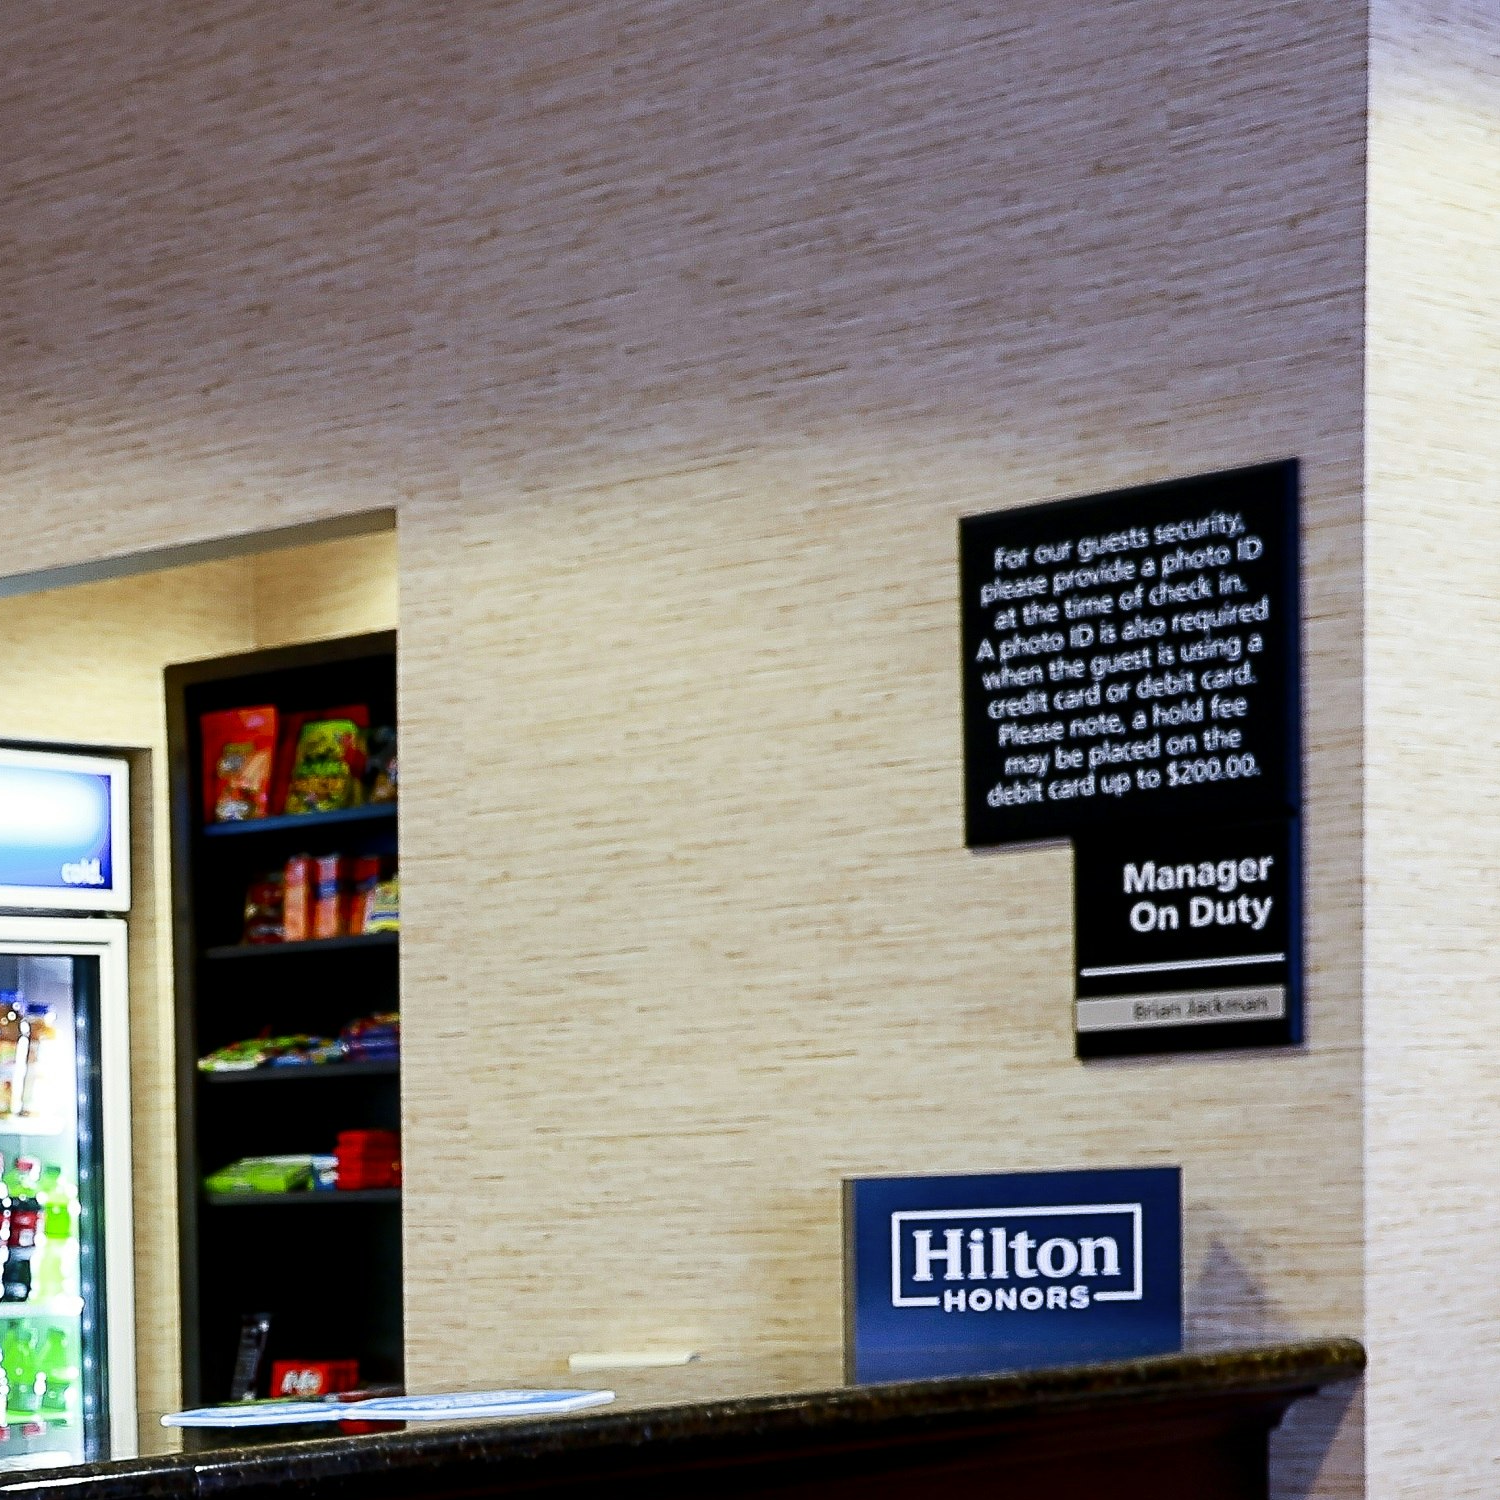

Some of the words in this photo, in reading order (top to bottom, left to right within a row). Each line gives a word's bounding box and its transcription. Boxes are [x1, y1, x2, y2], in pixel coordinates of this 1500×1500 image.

[980, 574, 1048, 608] please
[1052, 556, 1136, 597] provide
[1140, 556, 1156, 578] a
[1160, 544, 1231, 578] photo
[1236, 535, 1263, 562] ID
[994, 546, 1028, 572] For
[1033, 540, 1072, 564] our
[1077, 526, 1149, 563] guests
[994, 606, 1017, 631] at
[1022, 600, 1060, 626] the
[1064, 594, 1113, 619] time
[1118, 582, 1144, 611] of
[1148, 573, 1213, 606] check
[1218, 569, 1248, 595] in.
[976, 638, 994, 662] A
[999, 631, 1065, 667] photo
[1070, 623, 1094, 648] ID
[1100, 618, 1117, 644] is
[1121, 614, 1167, 641] also
[1171, 594, 1270, 642] required
[981, 661, 1043, 691] when
[1049, 656, 1086, 682] the
[1090, 646, 1151, 682] guest
[1157, 641, 1176, 666] is
[1180, 632, 1242, 663] using
[1247, 632, 1263, 653] a
[987, 690, 1049, 720] credit
[1053, 681, 1101, 711] card
[1105, 682, 1132, 703] or
[1135, 668, 1196, 700] debit
[1200, 659, 1257, 691] card.
[998, 721, 1065, 748] Please
[1131, 709, 1148, 730] a
[1152, 696, 1204, 727] hold
[1209, 693, 1248, 719] fee
[1004, 753, 1050, 778] may
[1054, 745, 1084, 770] be
[1088, 731, 1161, 771] placed
[1165, 733, 1197, 756] on
[1202, 725, 1243, 751] the
[986, 778, 1043, 808] debit
[1048, 769, 1096, 800] card
[1100, 771, 1132, 798] up
[1136, 767, 1162, 790] to
[1122, 855, 1274, 895] Manager
[1129, 901, 1180, 932] On
[1189, 893, 1273, 930] Duty
[911, 1227, 1122, 1282] Hilton
[944, 1285, 1090, 1312] HONORS
